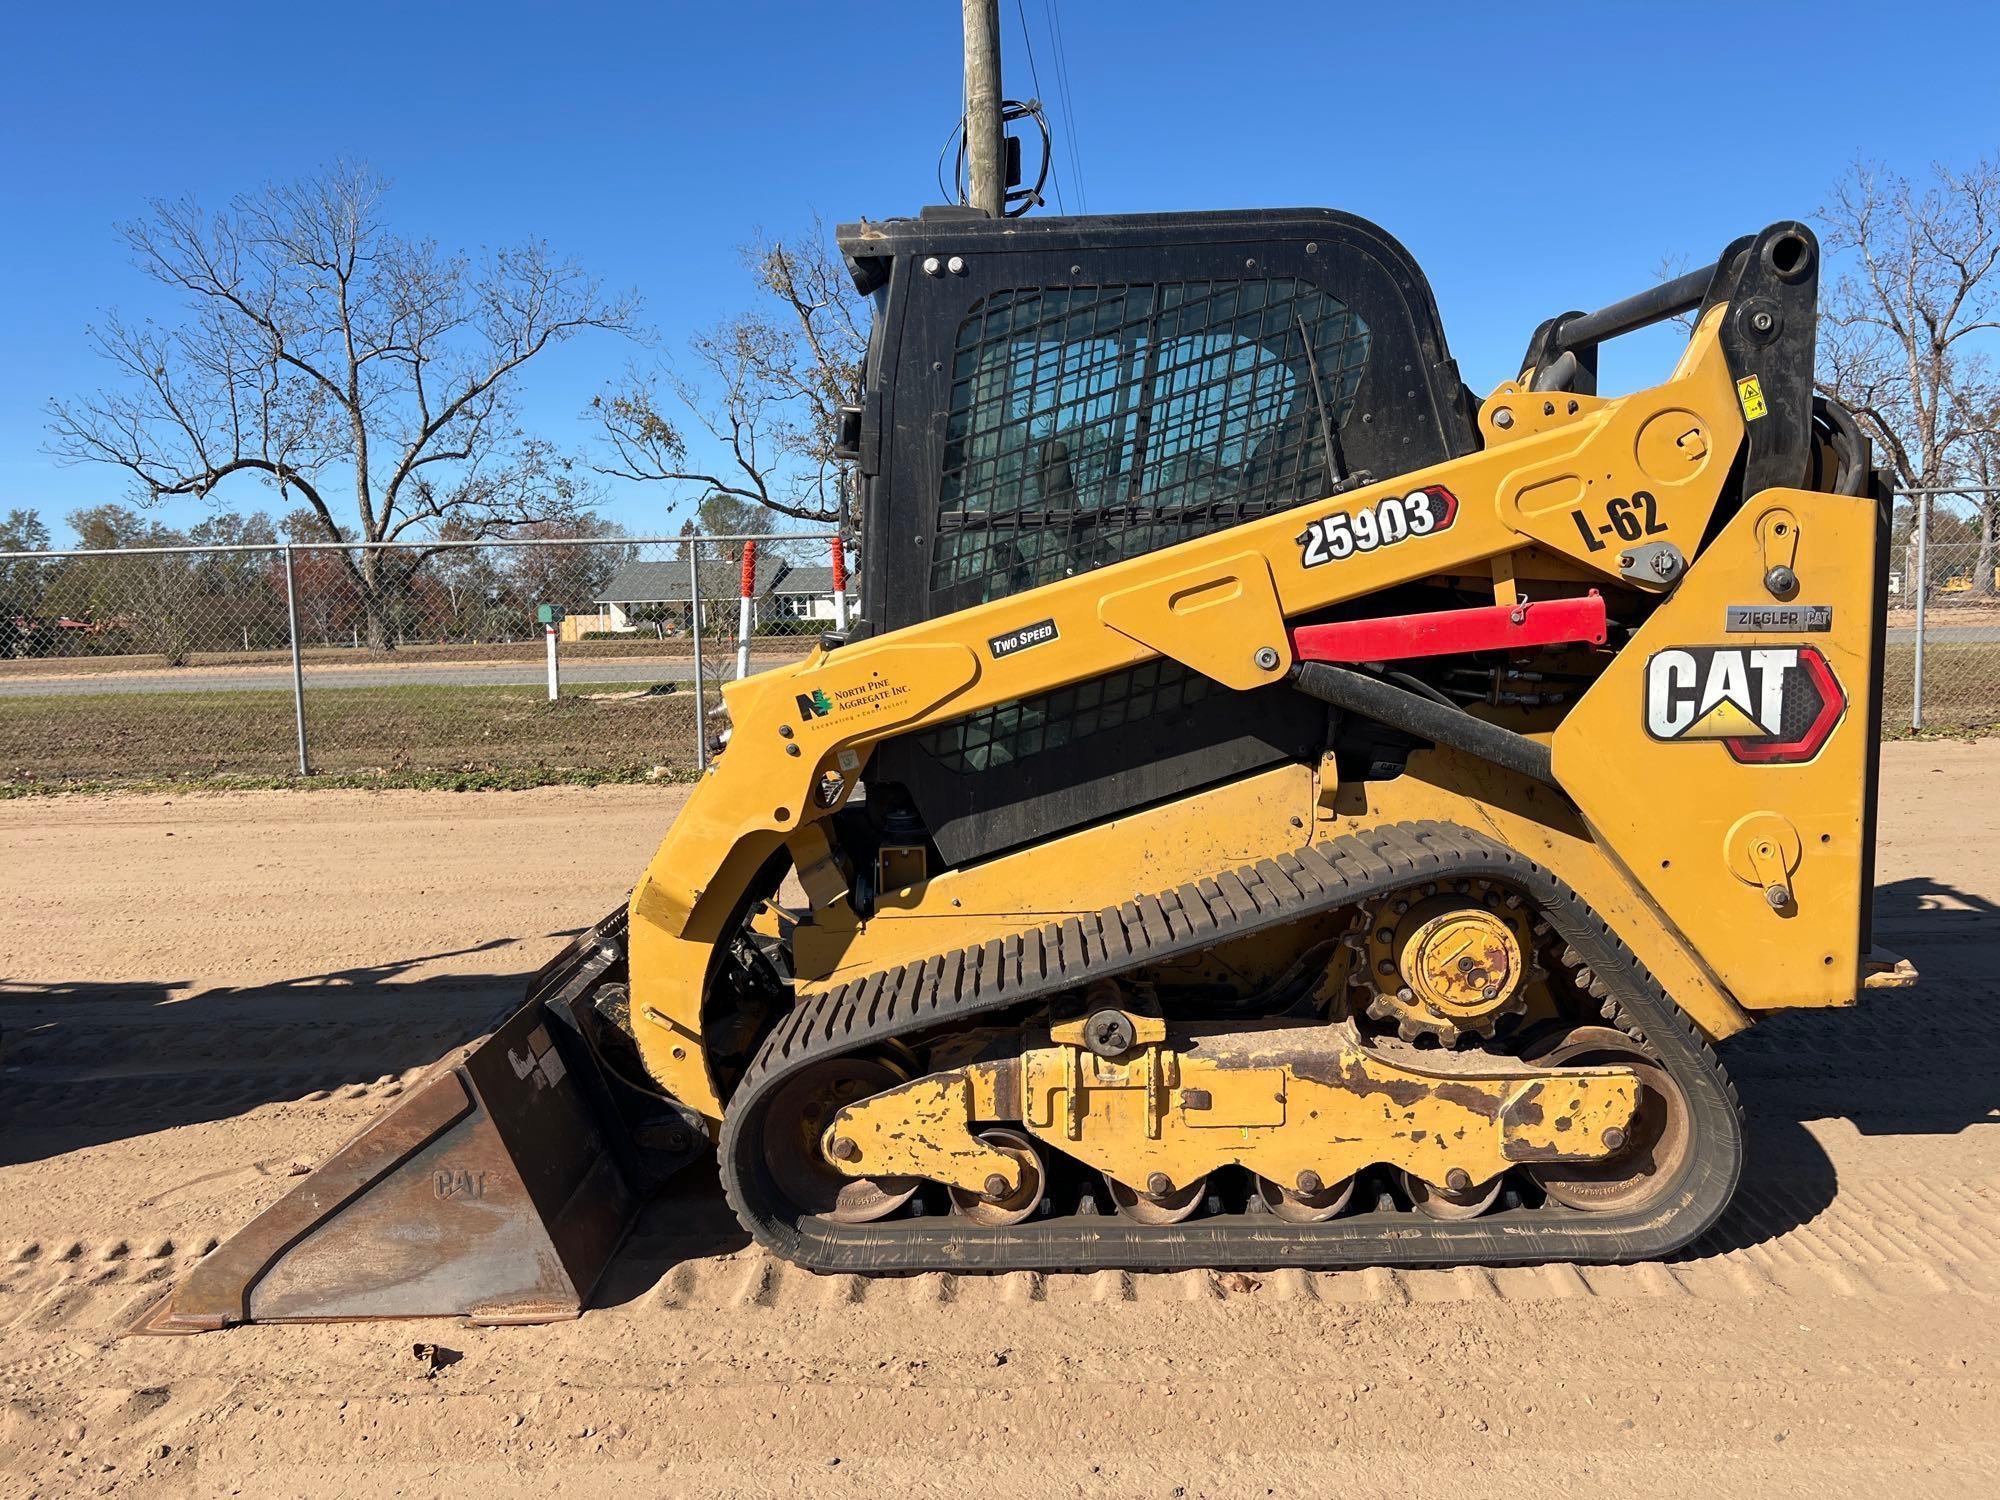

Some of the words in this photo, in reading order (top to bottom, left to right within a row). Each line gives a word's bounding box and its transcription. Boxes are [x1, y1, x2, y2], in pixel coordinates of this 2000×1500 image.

[1571, 490, 1668, 552] L-62
[1739, 611, 1799, 625] ZIEGLER
[1805, 610, 1829, 625] CAT
[994, 637, 1017, 653] TWO
[1020, 625, 1052, 645] SPEED
[834, 685, 867, 701] NORTH
[867, 679, 890, 694] PINE
[838, 690, 891, 712] AGGREGATE
[1649, 649, 1798, 738] CAT
[433, 1169, 485, 1200] CAT
